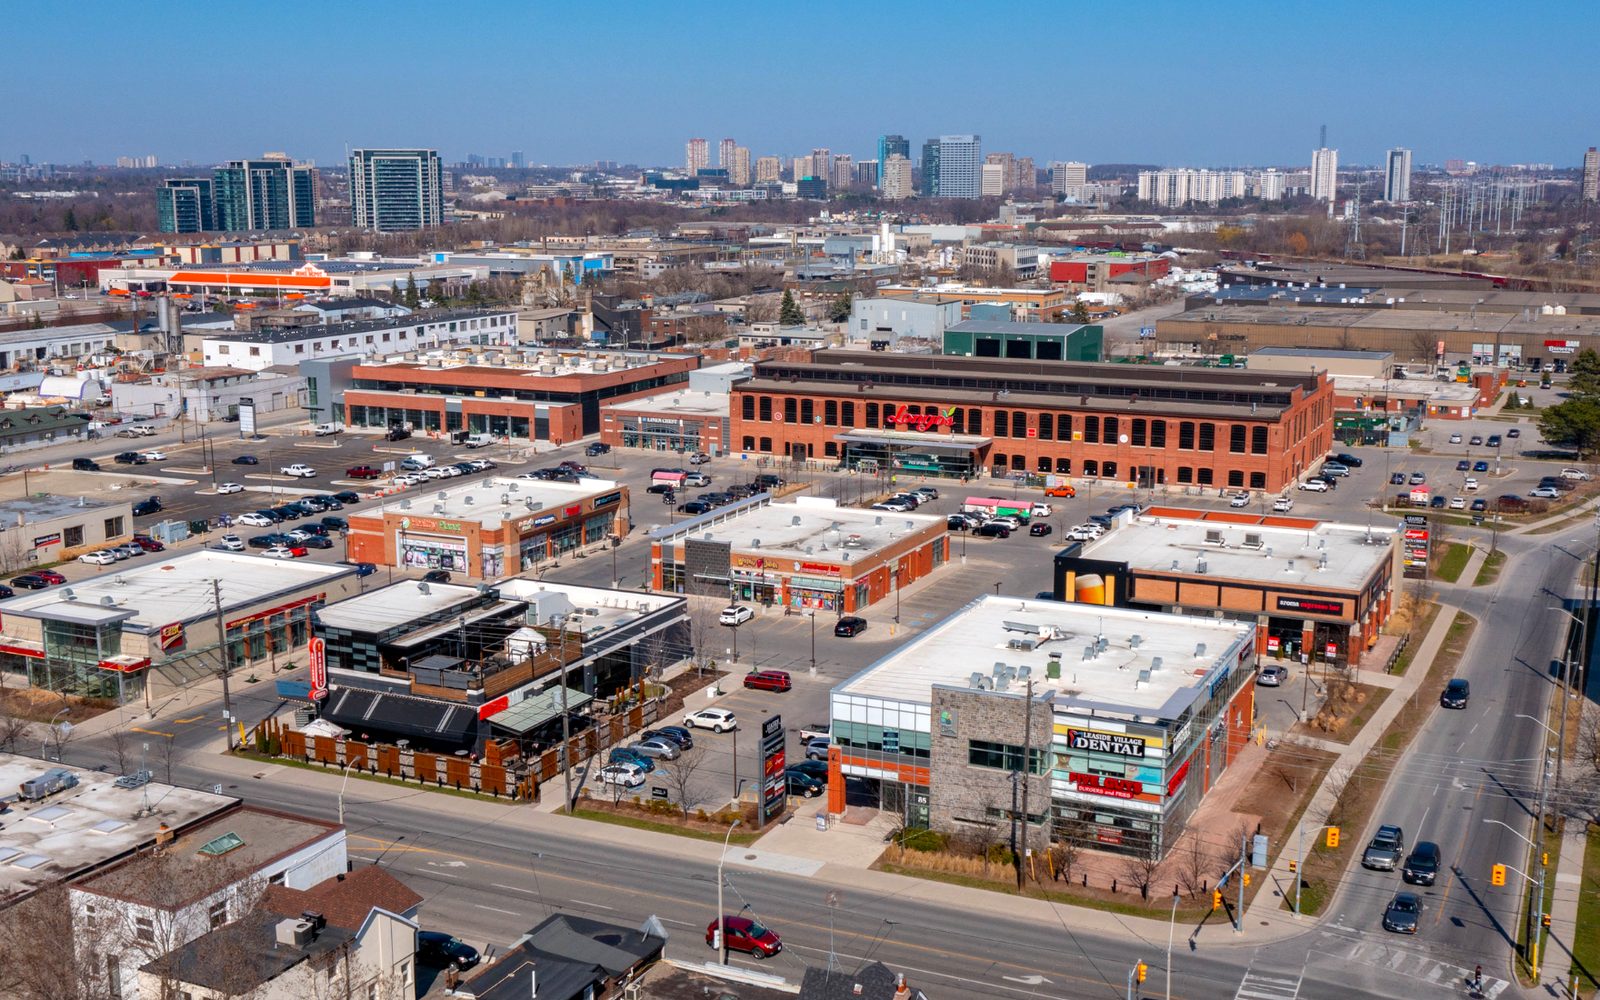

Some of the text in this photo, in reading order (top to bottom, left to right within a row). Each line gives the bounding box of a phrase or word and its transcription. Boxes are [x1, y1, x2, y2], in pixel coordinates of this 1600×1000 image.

[1083, 731, 1143, 746] LEASIDE VILLAGE
[1076, 737, 1143, 757] DENTAL
[1069, 771, 1143, 795] FIVE GUYS
[1078, 785, 1104, 794] BURGERS
[1115, 790, 1131, 798] FRIES
[917, 796, 927, 804] 85
